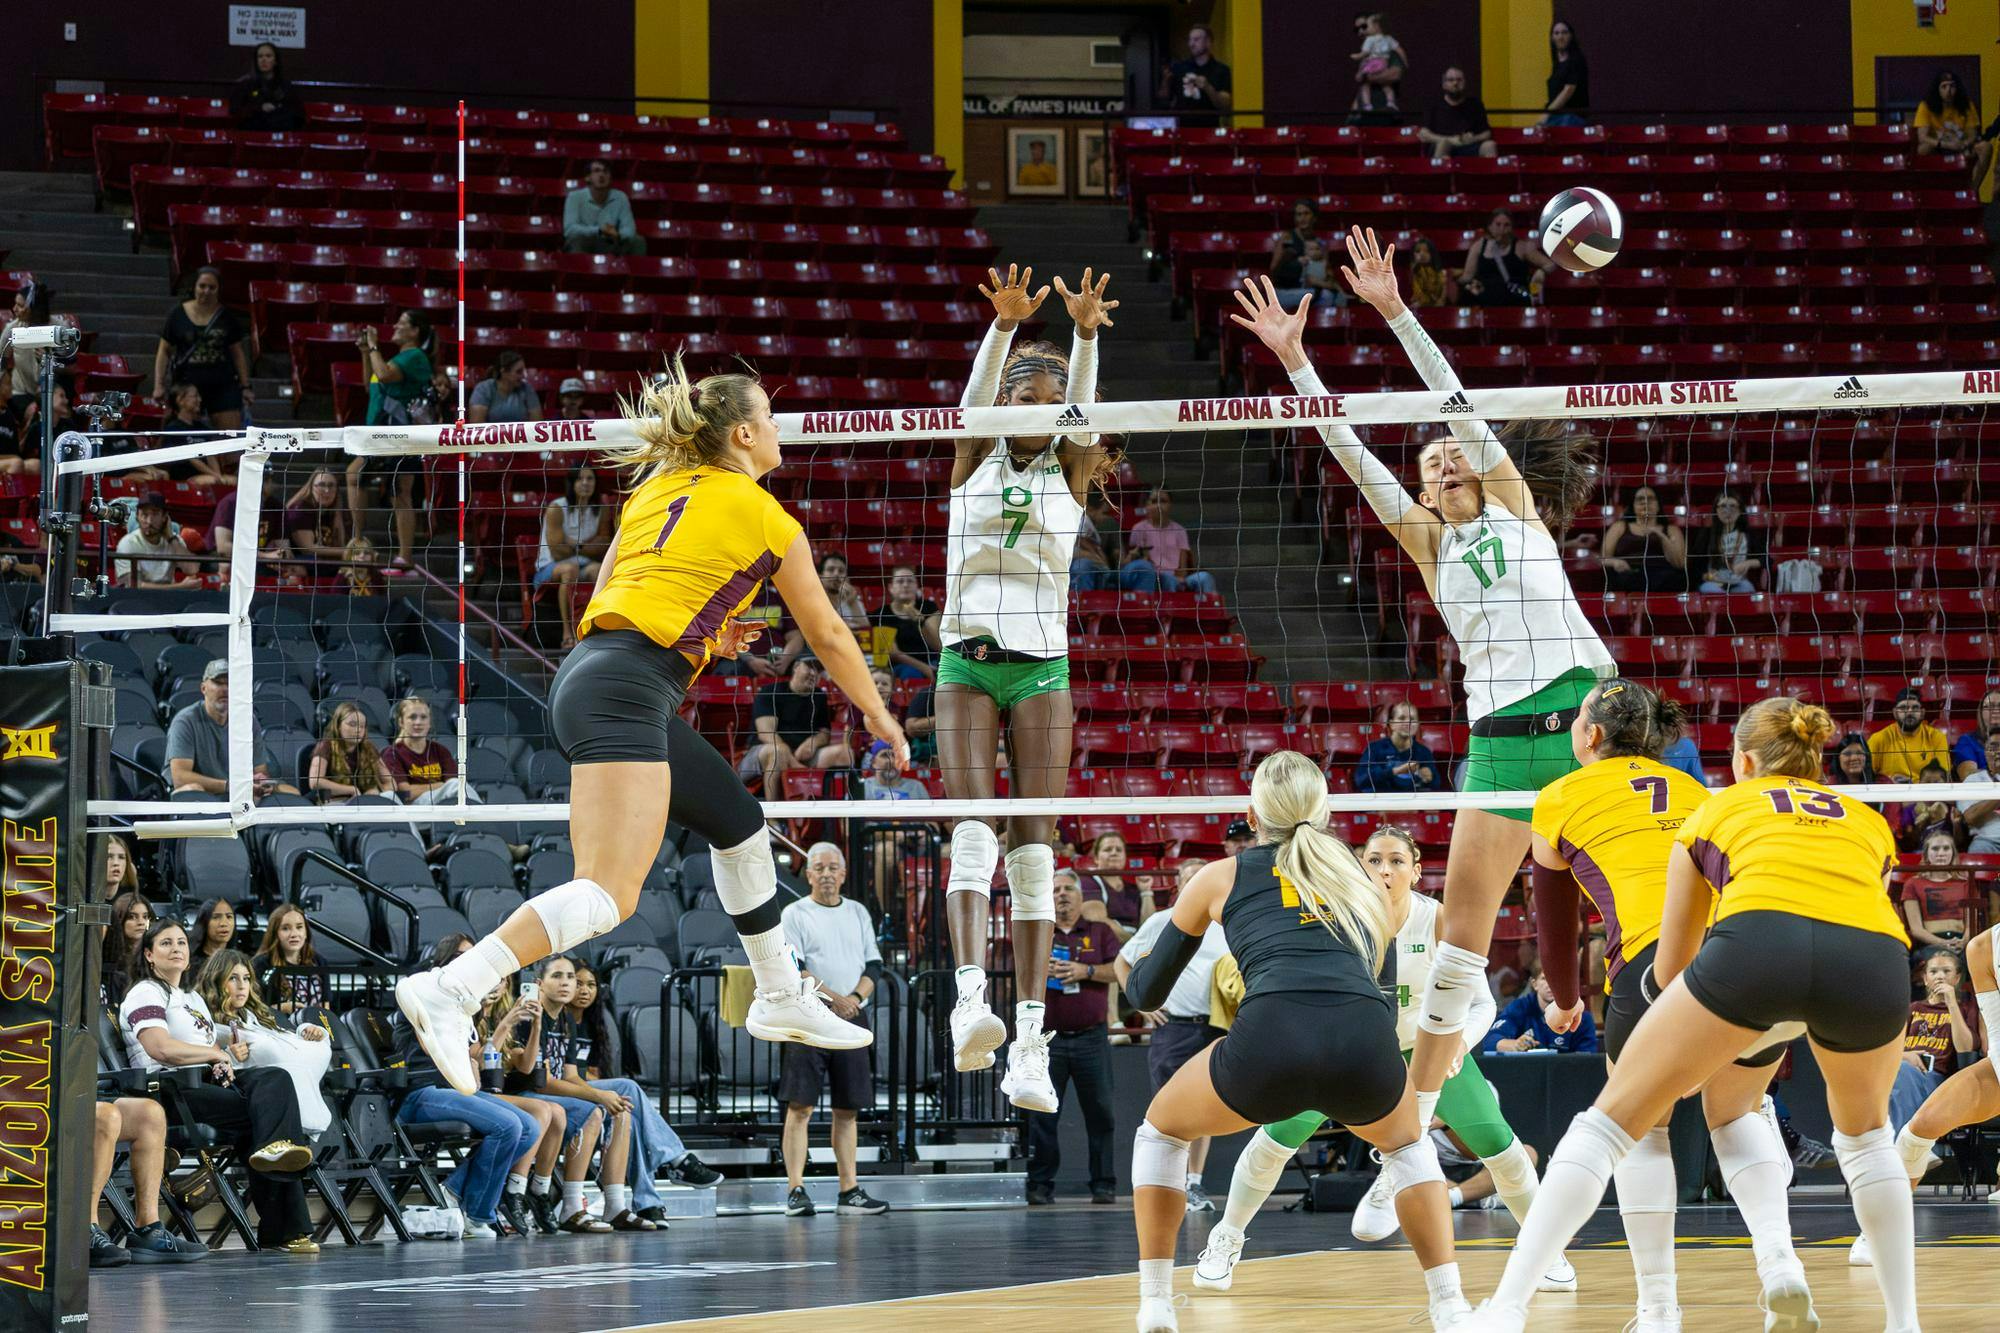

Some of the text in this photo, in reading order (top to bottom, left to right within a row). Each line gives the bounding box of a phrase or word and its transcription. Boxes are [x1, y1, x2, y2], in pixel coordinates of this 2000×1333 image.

[236, 27, 246, 35] IN
[988, 101, 1009, 114] OF
[1013, 100, 1064, 114] FAME'S
[1067, 101, 1104, 114] HALL
[1414, 321, 1447, 374] DUCKS
[1565, 381, 1738, 409] ARIZONA STATE
[1833, 389, 1869, 399] adidas
[802, 408, 966, 434] ARIZONA STATE
[1055, 417, 1089, 426] adidas
[1178, 395, 1347, 422] ARIZONA STATE
[1439, 404, 1474, 413] adidas
[438, 420, 597, 446] ARIZONA STATE
[653, 495, 691, 549] 1
[1002, 510, 1029, 549] 7
[1462, 536, 1507, 589] 17
[0, 725, 57, 760] XII
[1629, 775, 1669, 815] 7
[1760, 788, 1847, 820] 13
[0, 816, 57, 1291] ARIZONA STATE
